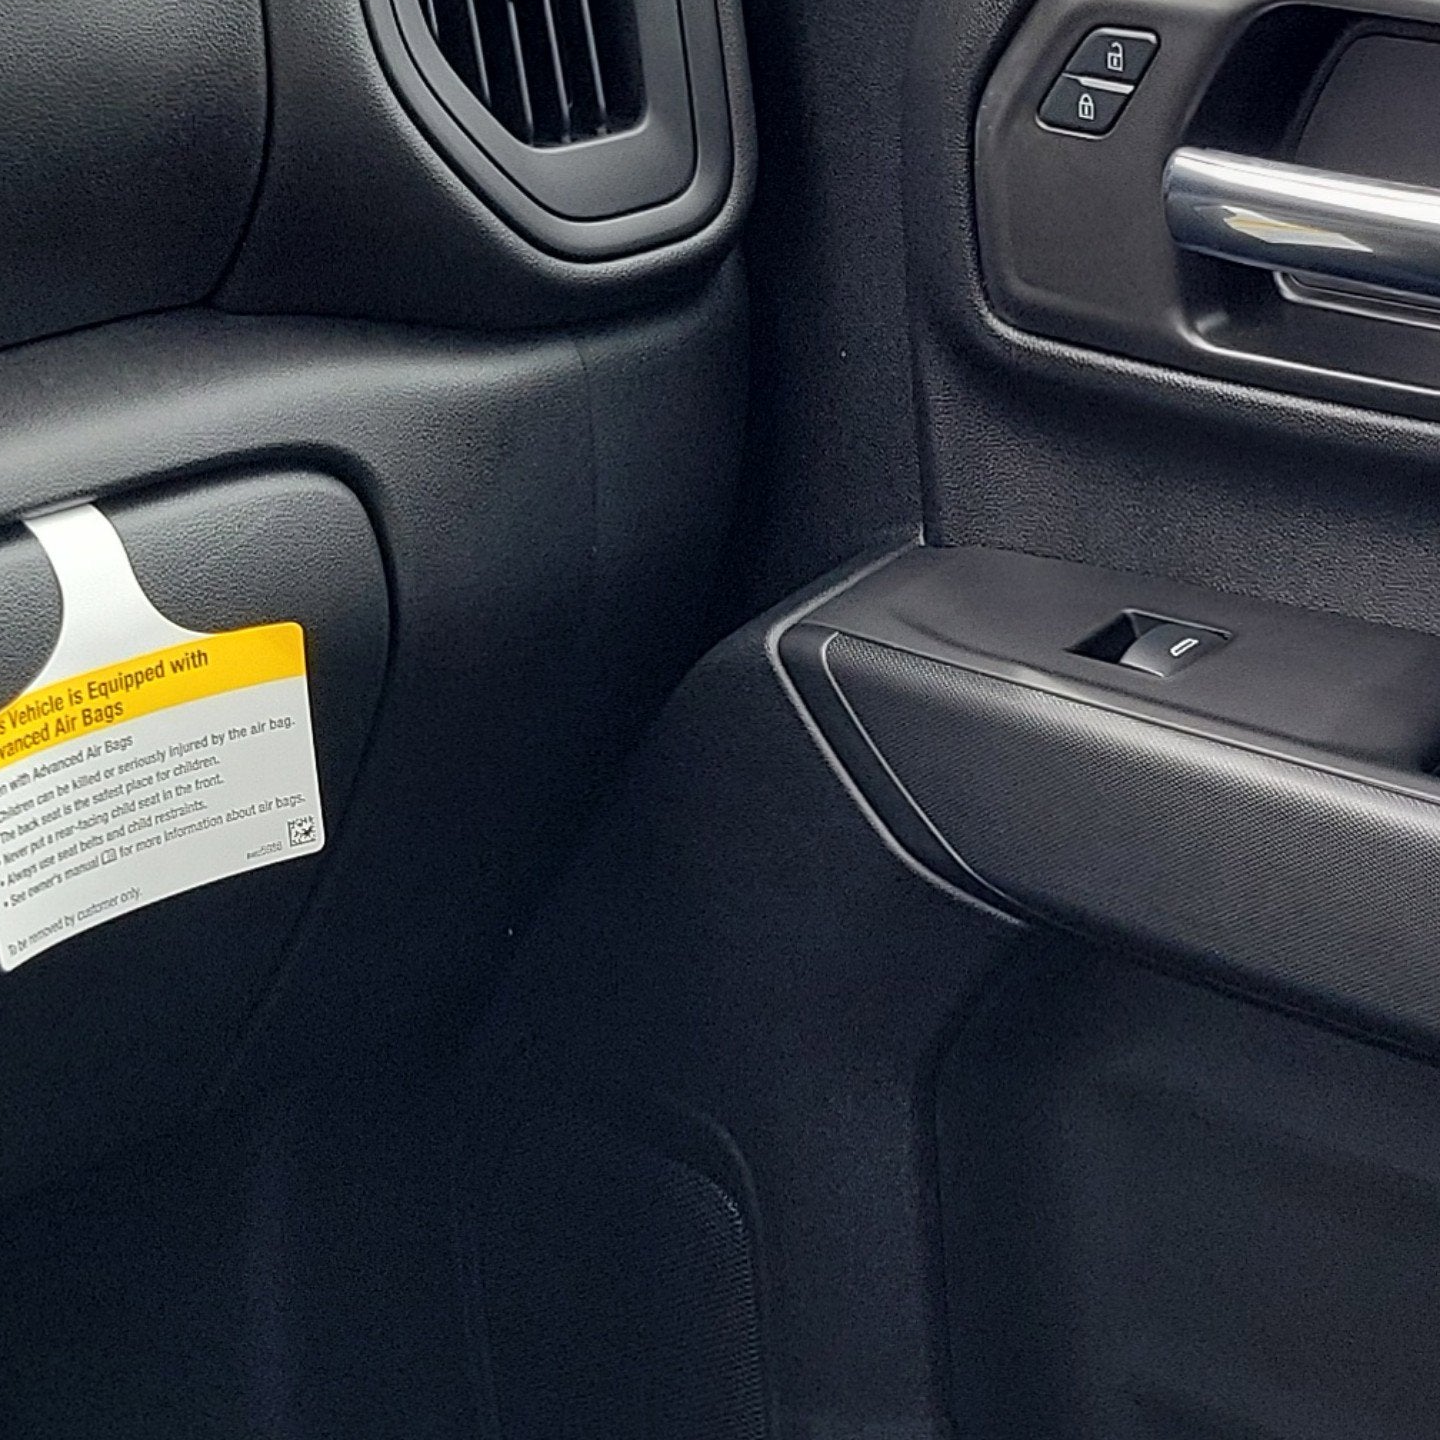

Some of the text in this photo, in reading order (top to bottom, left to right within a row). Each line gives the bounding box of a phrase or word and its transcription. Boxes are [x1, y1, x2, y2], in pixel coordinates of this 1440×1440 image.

[8, 695, 65, 729] Vehicle
[68, 688, 84, 706] is
[87, 660, 166, 700] Equipped
[170, 649, 209, 674] with
[54, 714, 78, 738] Air
[82, 701, 124, 727] Bags
[33, 750, 84, 779] Advanced
[86, 744, 102, 759] Air
[104, 735, 134, 754] Bags
[103, 767, 116, 780] or
[118, 749, 166, 775] seriously
[169, 736, 208, 758] injured
[211, 732, 225, 747] by
[228, 727, 247, 740] the
[250, 721, 266, 735] air
[269, 716, 295, 730] bag.
[63, 803, 72, 816] is
[74, 797, 91, 812] the
[92, 784, 124, 804] safest
[126, 775, 154, 796] place
[156, 768, 171, 782] for
[111, 800, 136, 820] child
[138, 792, 160, 810] seat
[162, 788, 173, 802] in
[175, 782, 192, 797] the
[106, 824, 126, 841] and
[127, 815, 153, 834] child
[119, 844, 134, 858] for
[136, 835, 162, 853] more
[164, 814, 224, 842] information
[225, 804, 258, 823] about
[258, 799, 274, 813] air
[77, 895, 119, 922] customer
